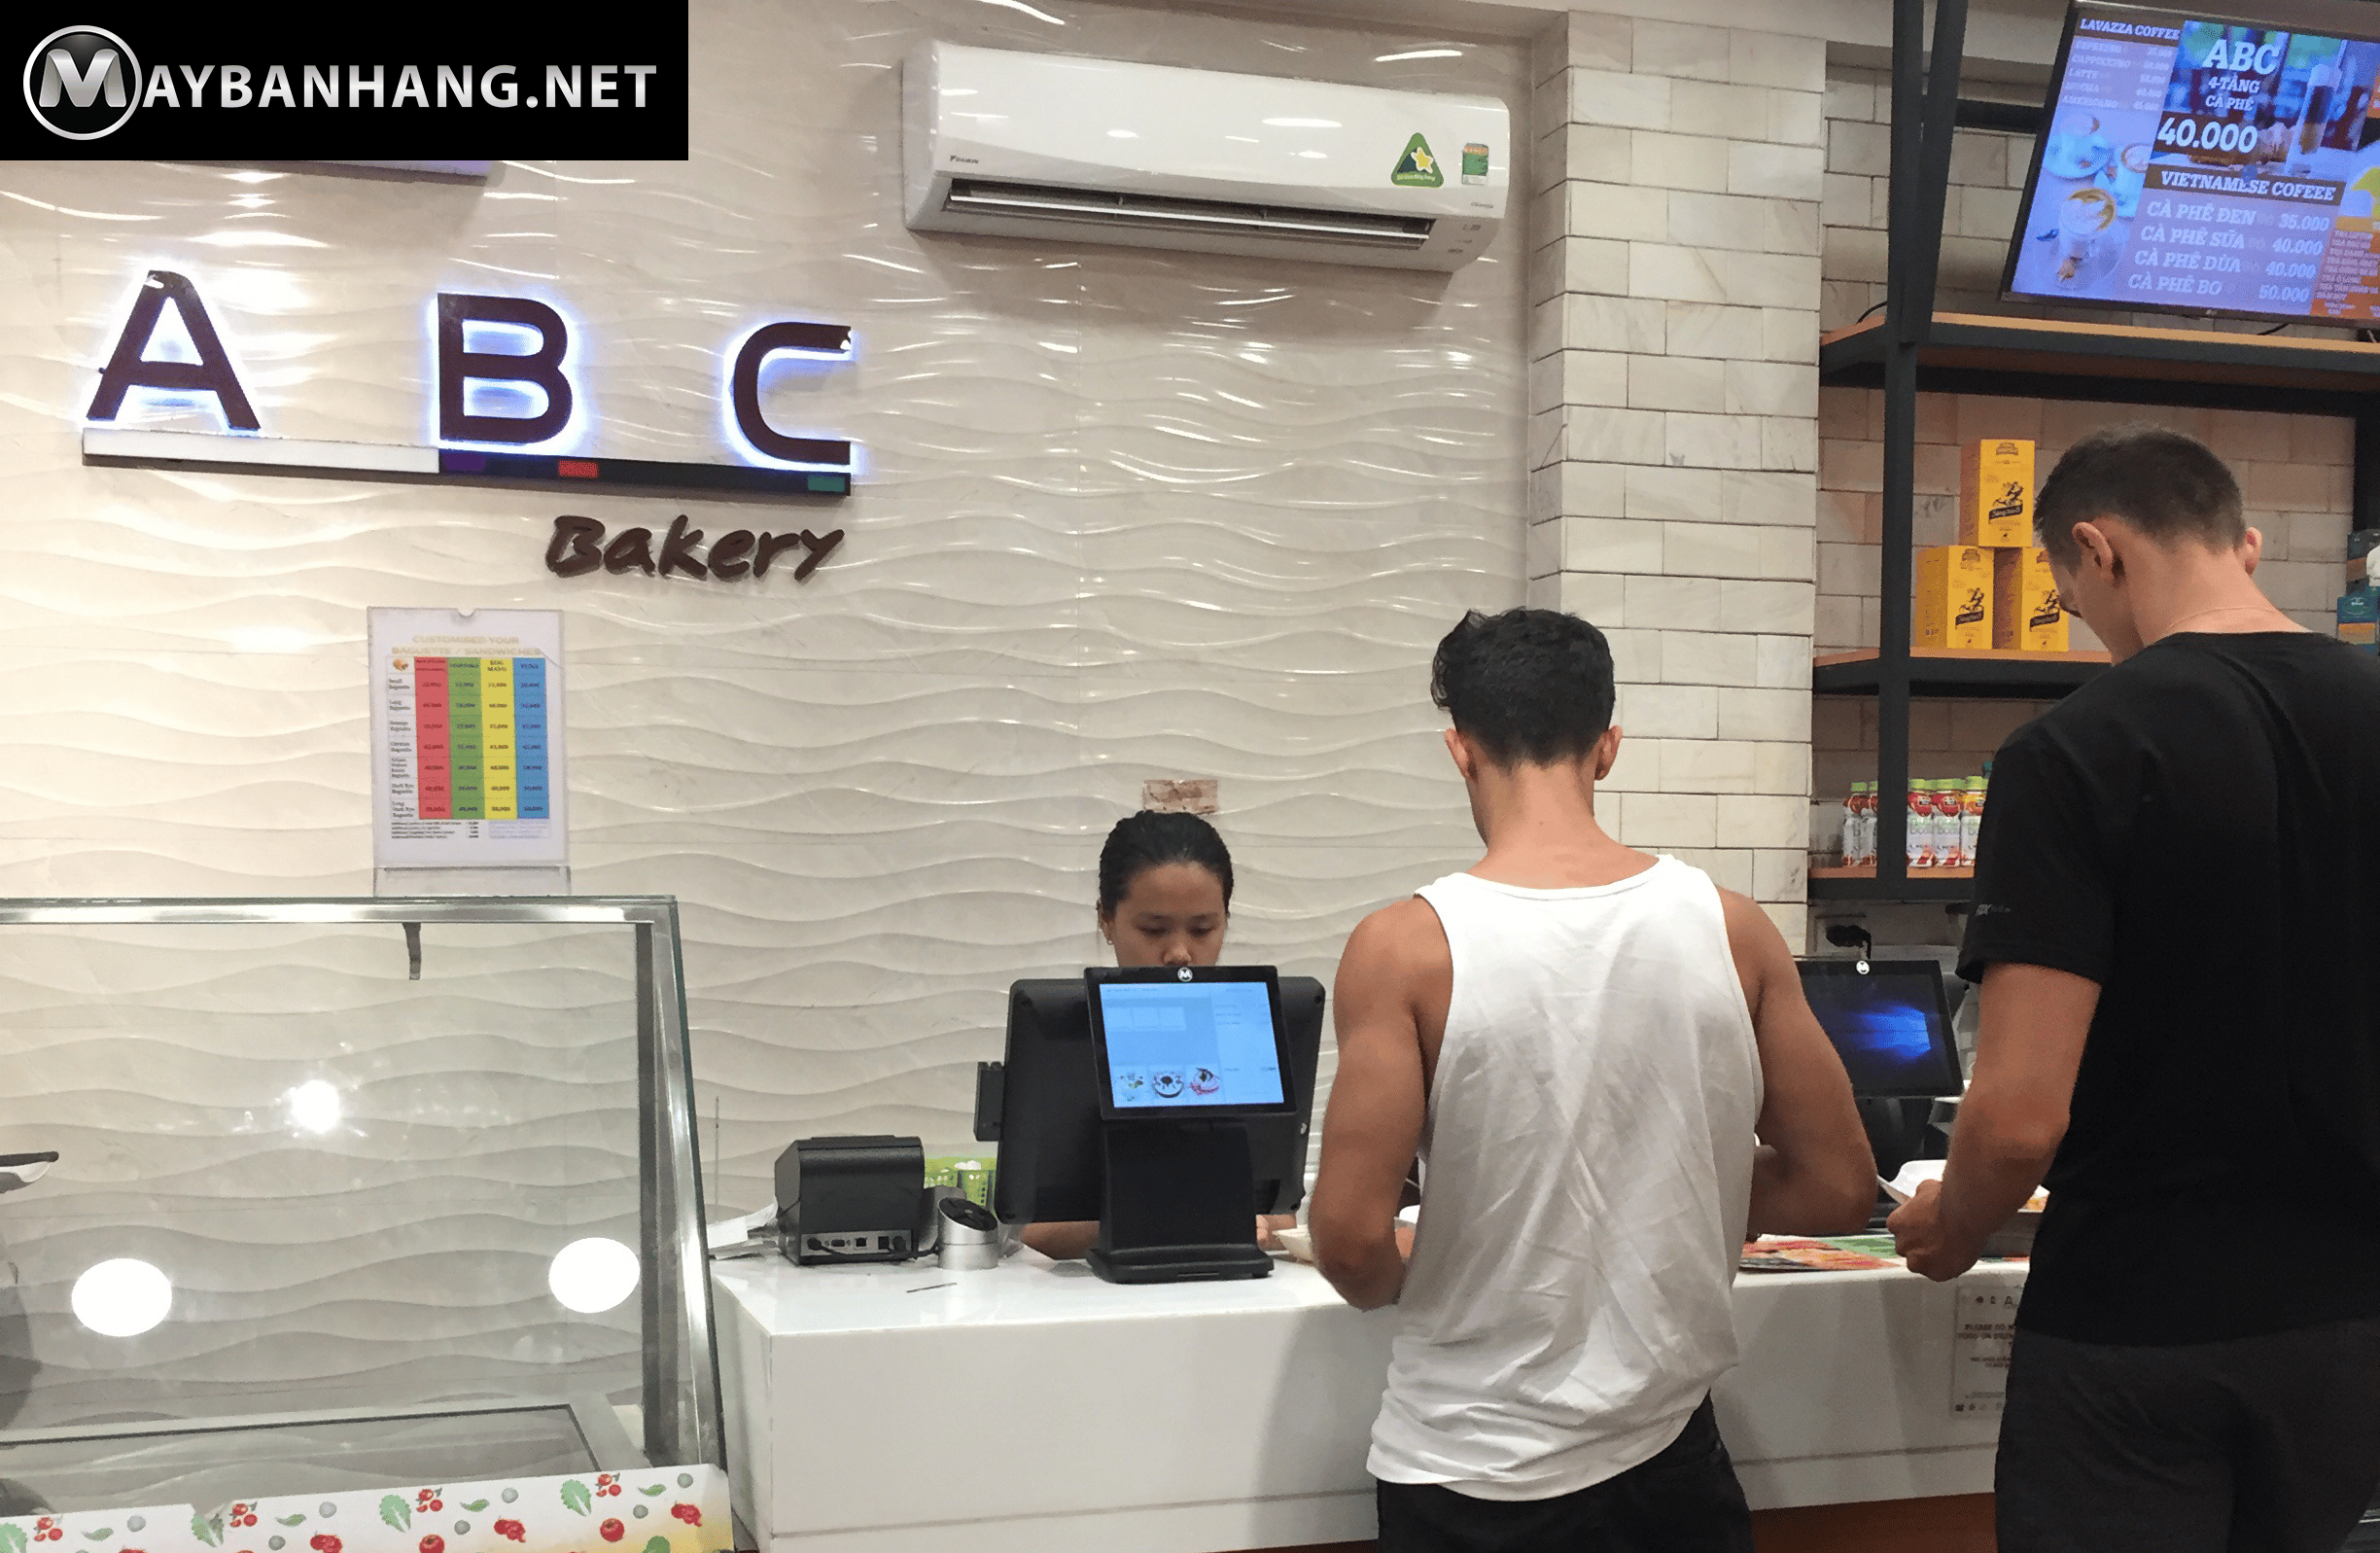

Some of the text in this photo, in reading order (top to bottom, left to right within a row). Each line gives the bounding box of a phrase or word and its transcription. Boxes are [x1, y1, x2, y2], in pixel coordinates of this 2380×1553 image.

[2080, 18, 2181, 41] LAVAZZA COFFEE
[2201, 38, 2281, 75] ABC
[2156, 117, 2259, 155] 40.000
[2161, 170, 2270, 194] VIETNAMESE
[2176, 201, 2215, 223] PHÊ
[2278, 213, 2330, 232] 35.000
[2169, 226, 2209, 246] PHÊ
[2272, 237, 2324, 256] 40.000
[2162, 251, 2202, 270] PHÊ
[2265, 261, 2317, 279] 40.000
[2258, 284, 2310, 303] 50.000
[544, 514, 844, 583] Bakery
